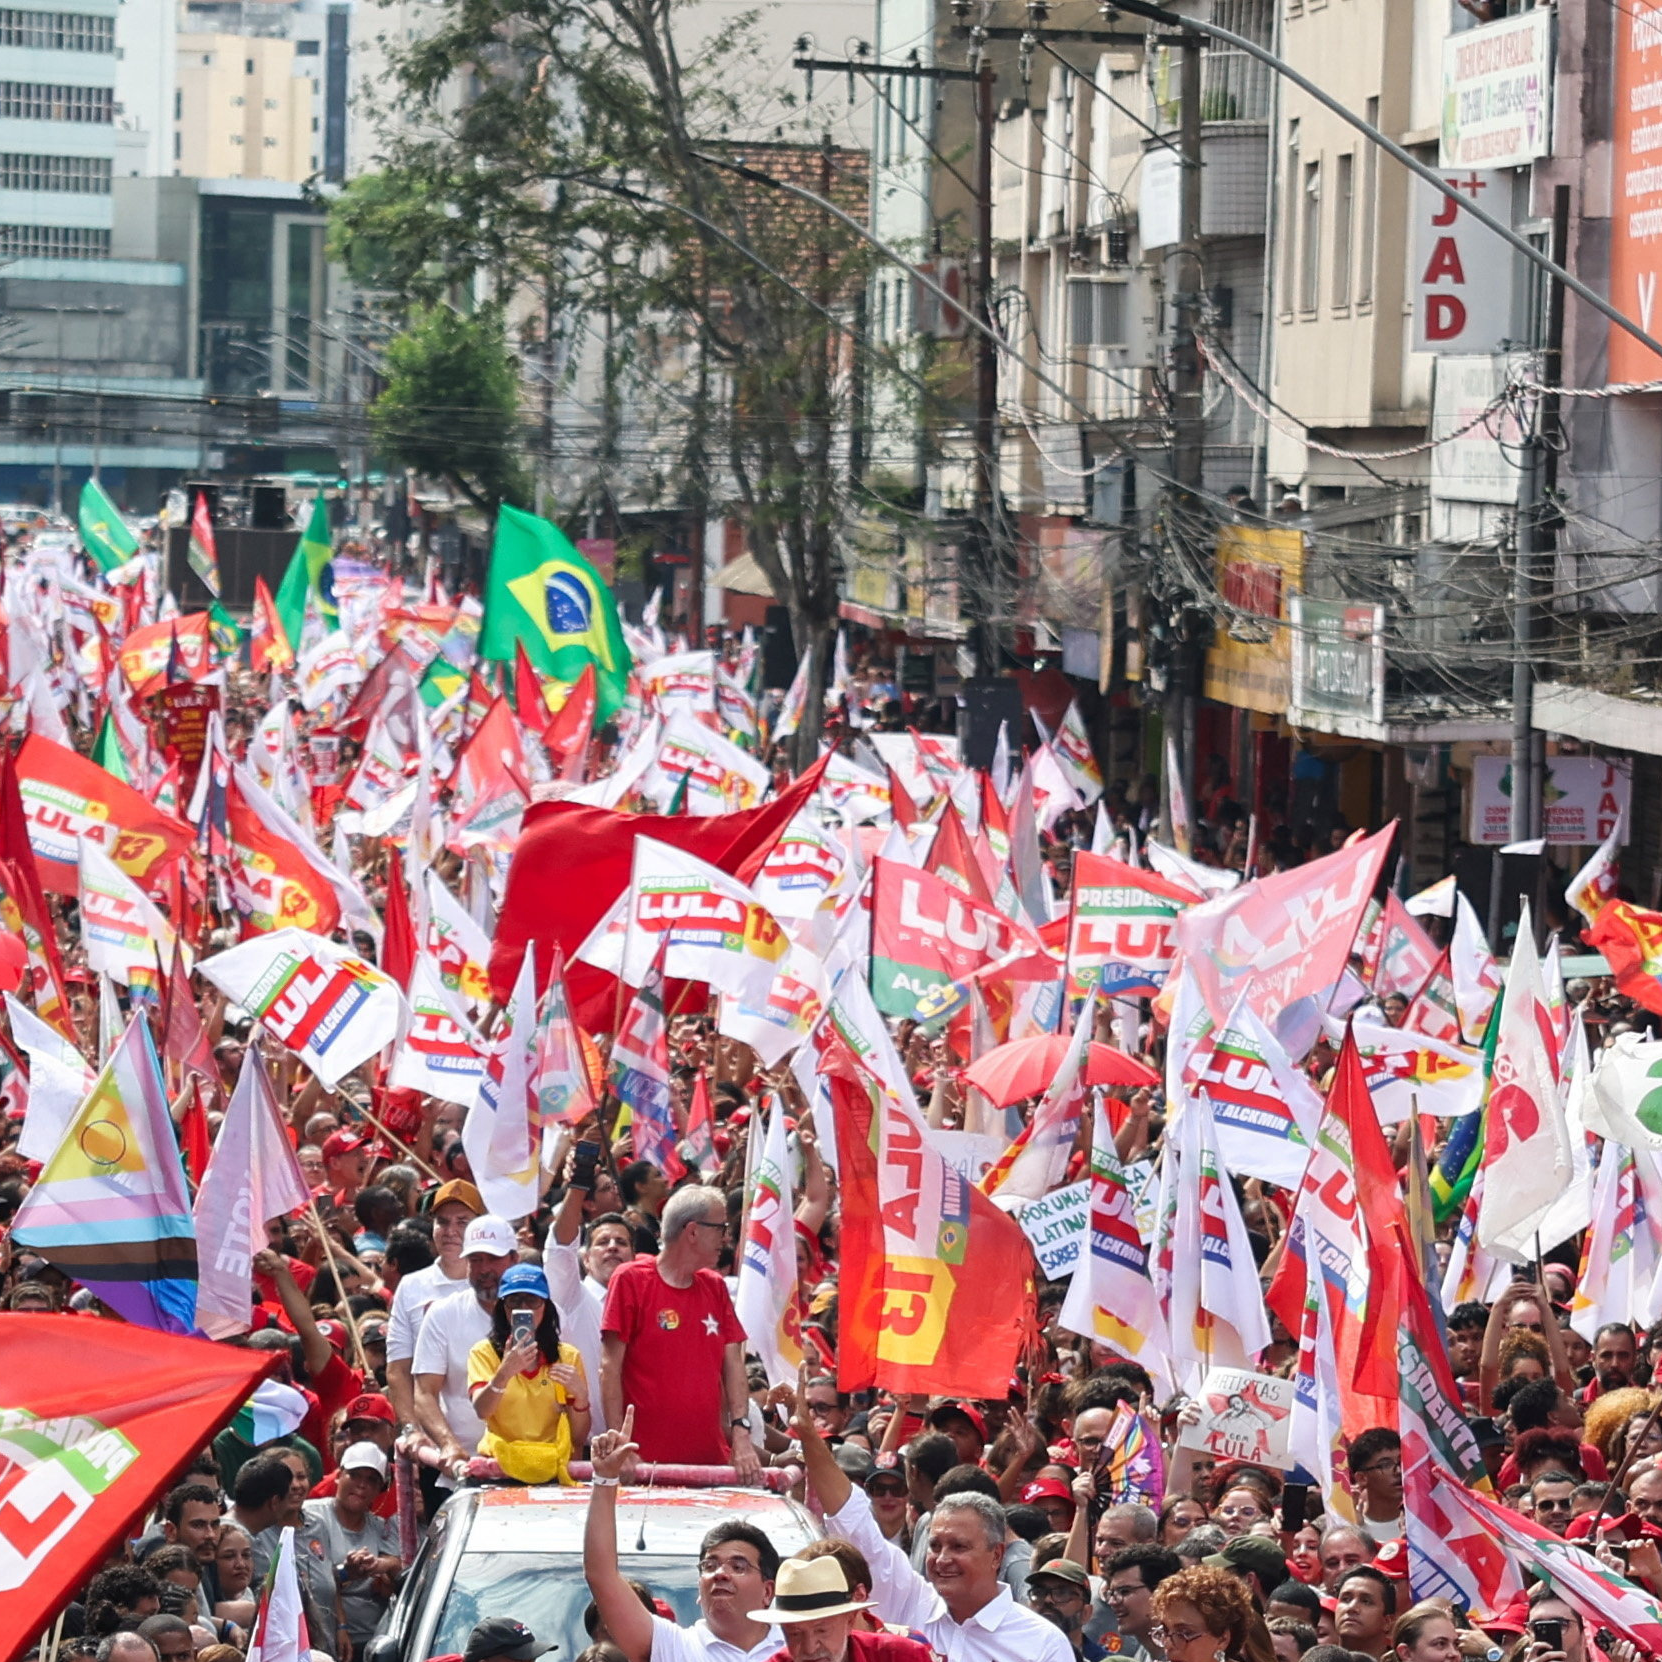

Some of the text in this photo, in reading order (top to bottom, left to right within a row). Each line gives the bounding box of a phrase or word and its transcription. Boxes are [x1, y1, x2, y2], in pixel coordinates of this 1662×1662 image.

[1421, 178, 1466, 341] JAD
[661, 746, 725, 781] LULA
[1597, 765, 1618, 840] JAD
[639, 874, 710, 892] PRESIDENTE
[637, 895, 742, 922] LULA
[749, 908, 779, 947] 13
[1077, 922, 1179, 958] LUL
[1200, 1056, 1283, 1099] LUL
[1223, 1104, 1290, 1132] ALCKMIN
[1019, 1192, 1077, 1226] POR UMA
[470, 1231, 496, 1241] LULA
[1040, 1240, 1080, 1271] SOBER
[1211, 1373, 1281, 1400] ARTISTAS
[1210, 1435, 1262, 1463] LULA
